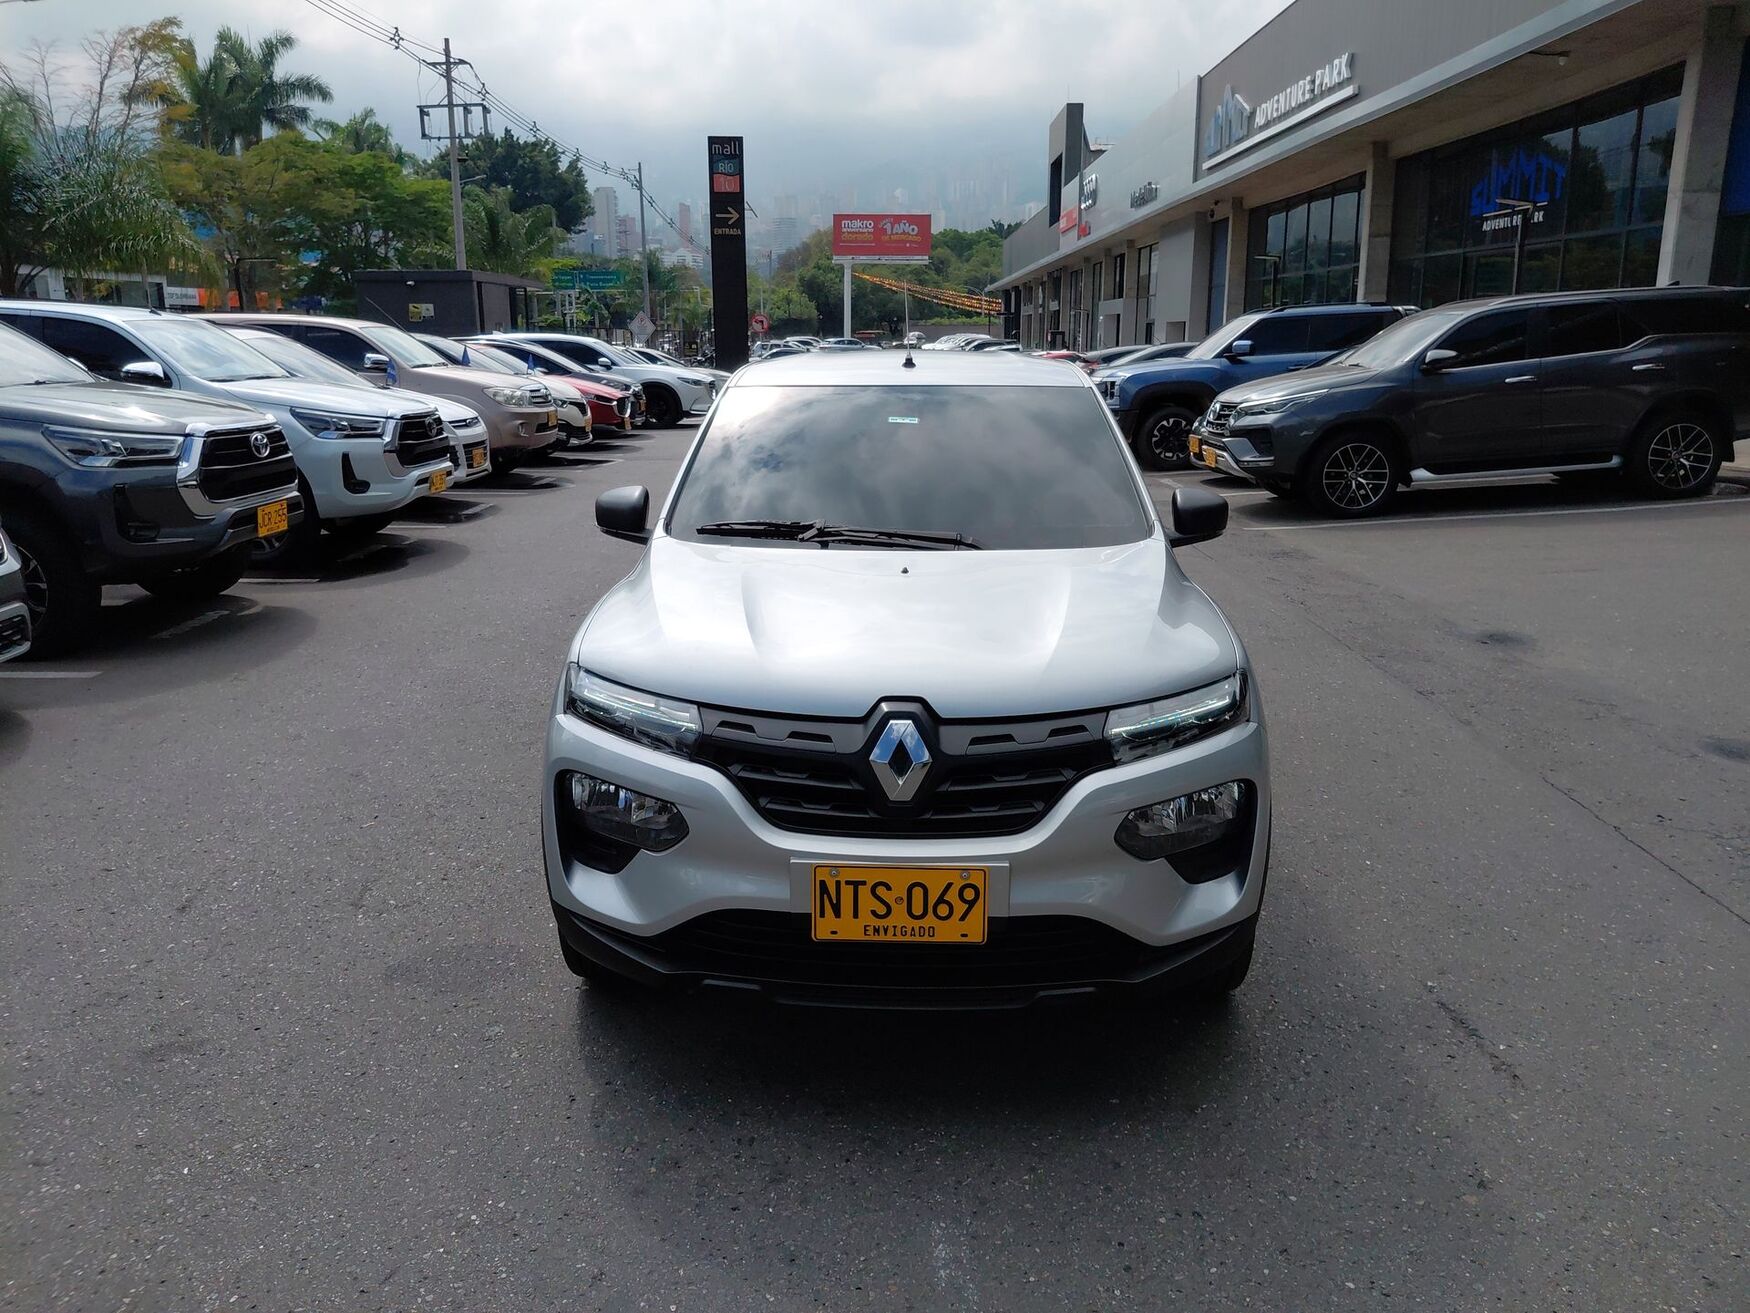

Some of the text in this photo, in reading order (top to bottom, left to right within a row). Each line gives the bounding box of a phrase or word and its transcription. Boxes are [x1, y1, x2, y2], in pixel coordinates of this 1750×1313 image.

[1254, 76, 1314, 129] ADVENTURE
[1314, 52, 1353, 95] PARK
[711, 141, 740, 155] mall
[842, 219, 874, 229] makro
[893, 221, 919, 235] AÑO
[713, 228, 742, 236] ENTRADA
[818, 879, 981, 922] NTS 069
[863, 924, 936, 938] ENVIGADO
